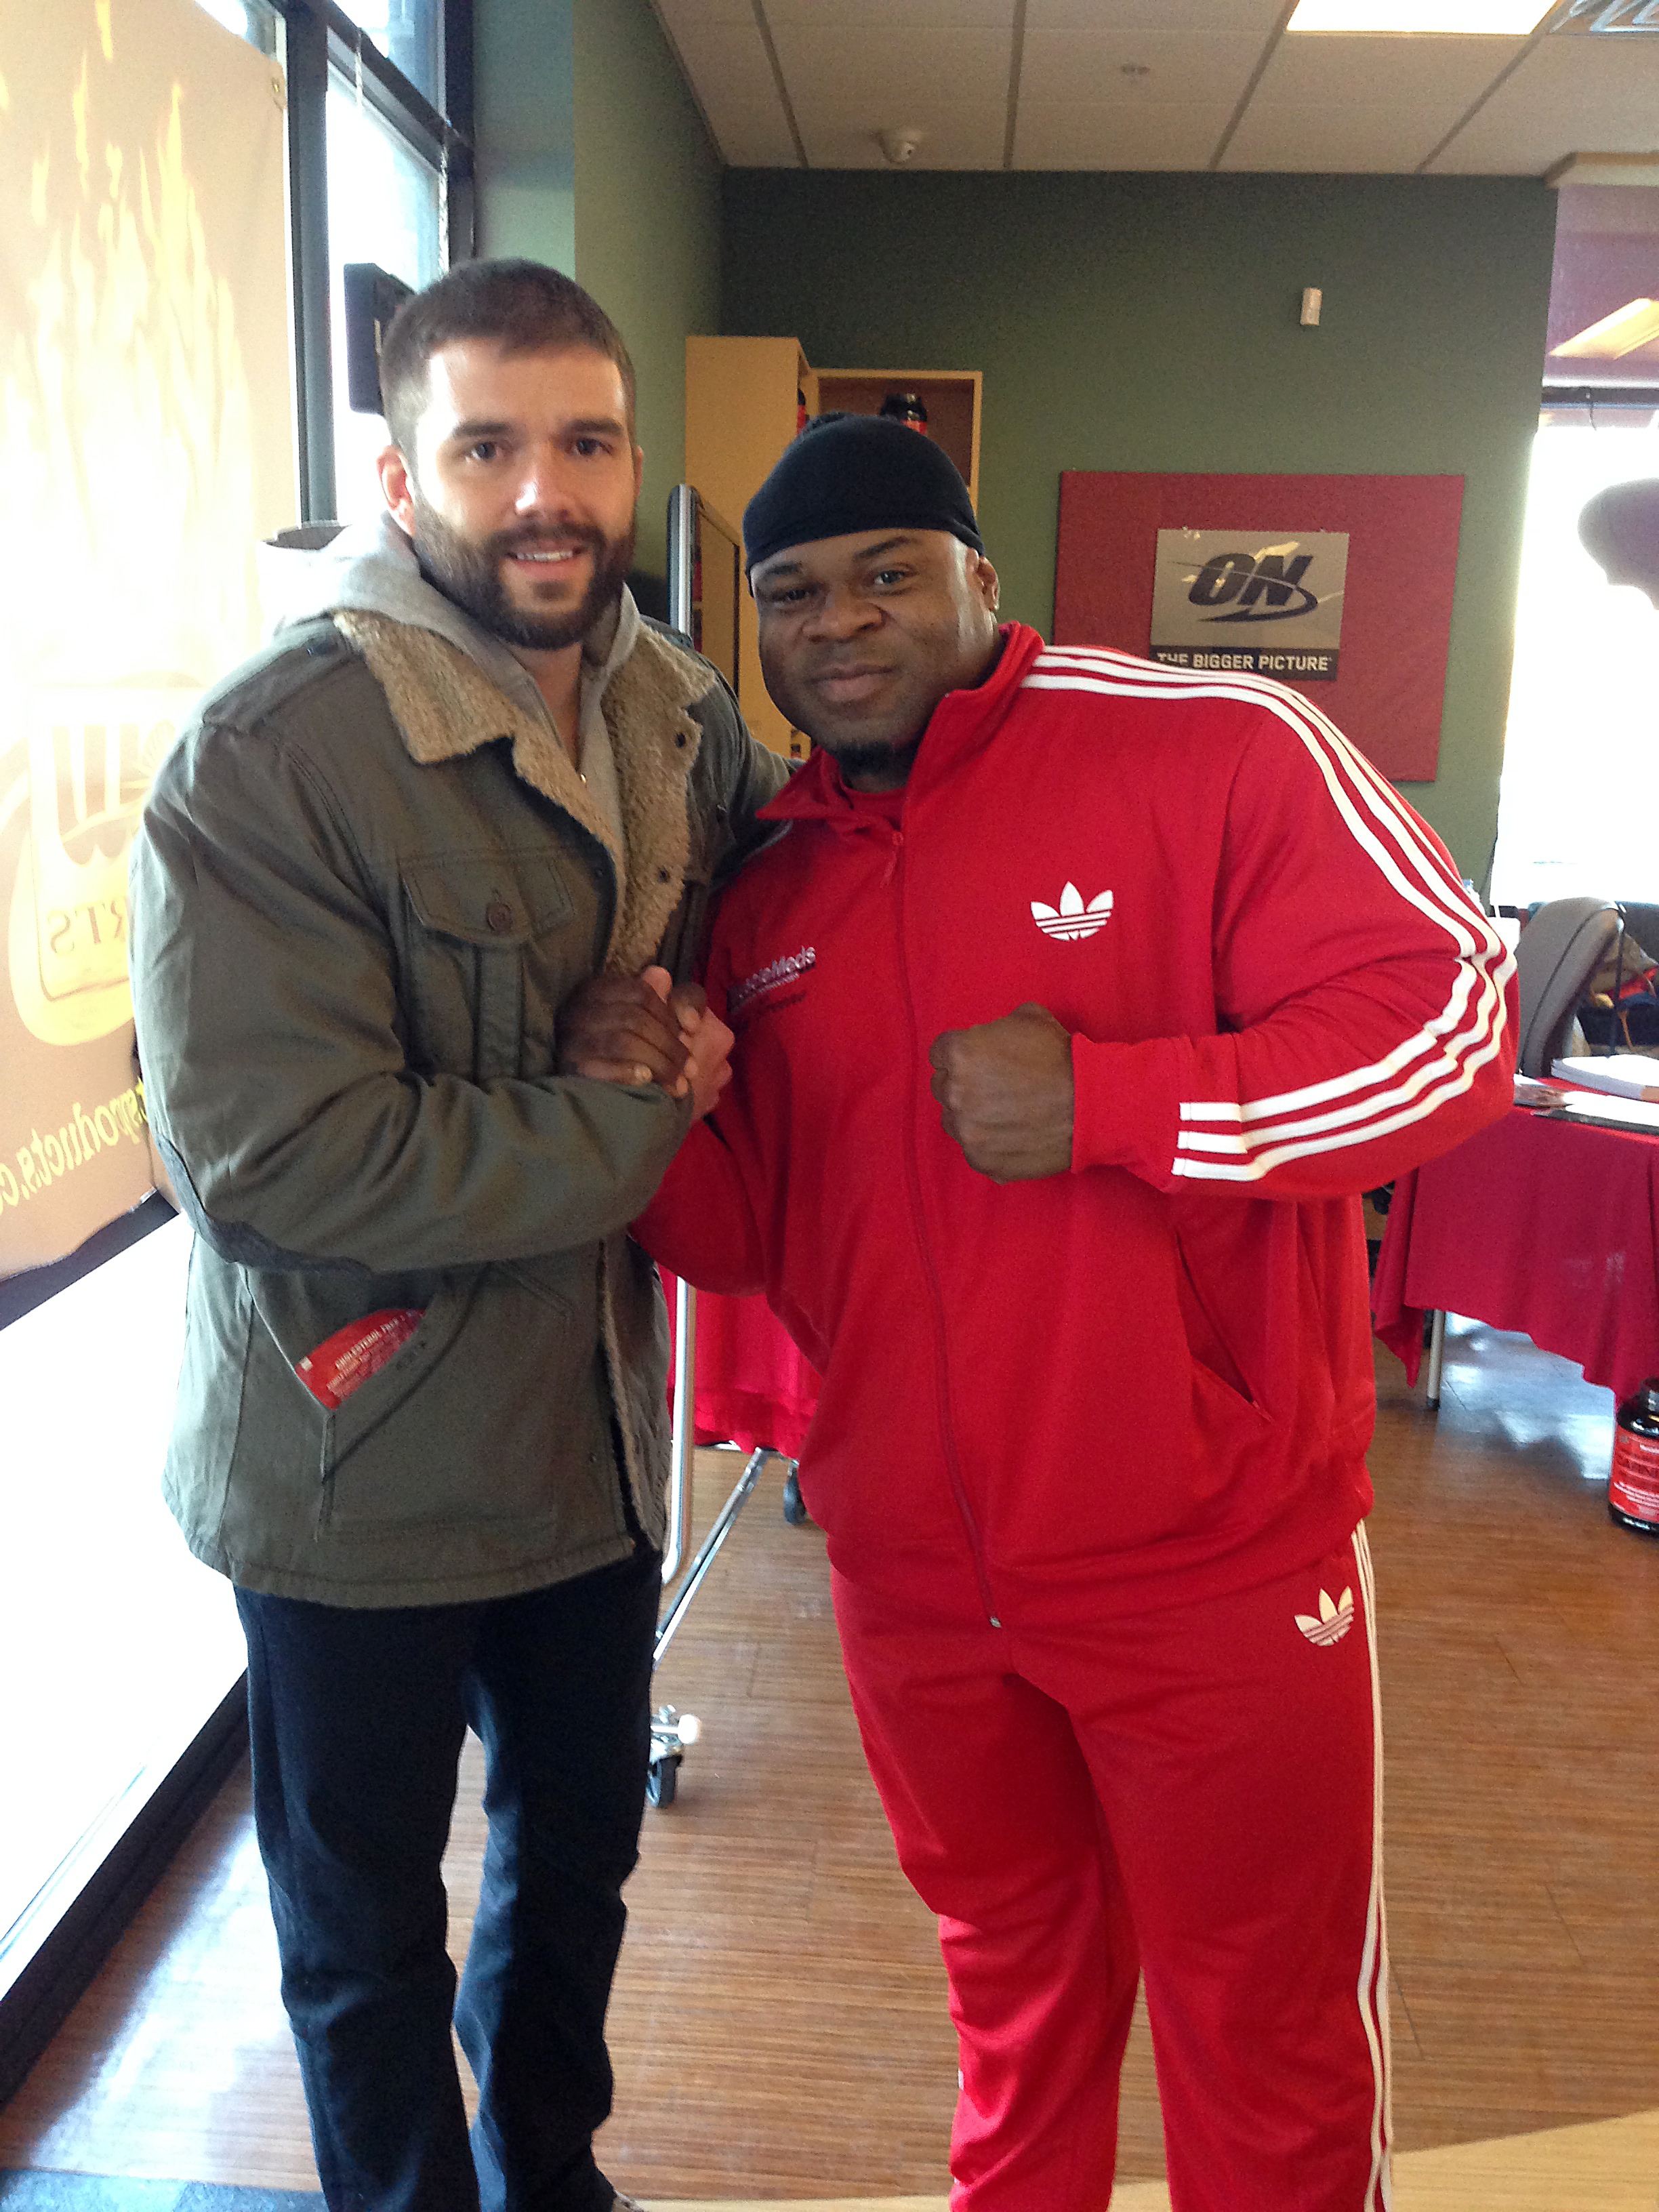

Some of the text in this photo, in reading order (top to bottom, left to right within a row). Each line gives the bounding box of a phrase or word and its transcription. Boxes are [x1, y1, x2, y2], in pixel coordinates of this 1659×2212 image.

[1188, 554, 1313, 607] ON
[1192, 653, 1254, 670] BIGGER
[1257, 655, 1329, 672] PICTURE
